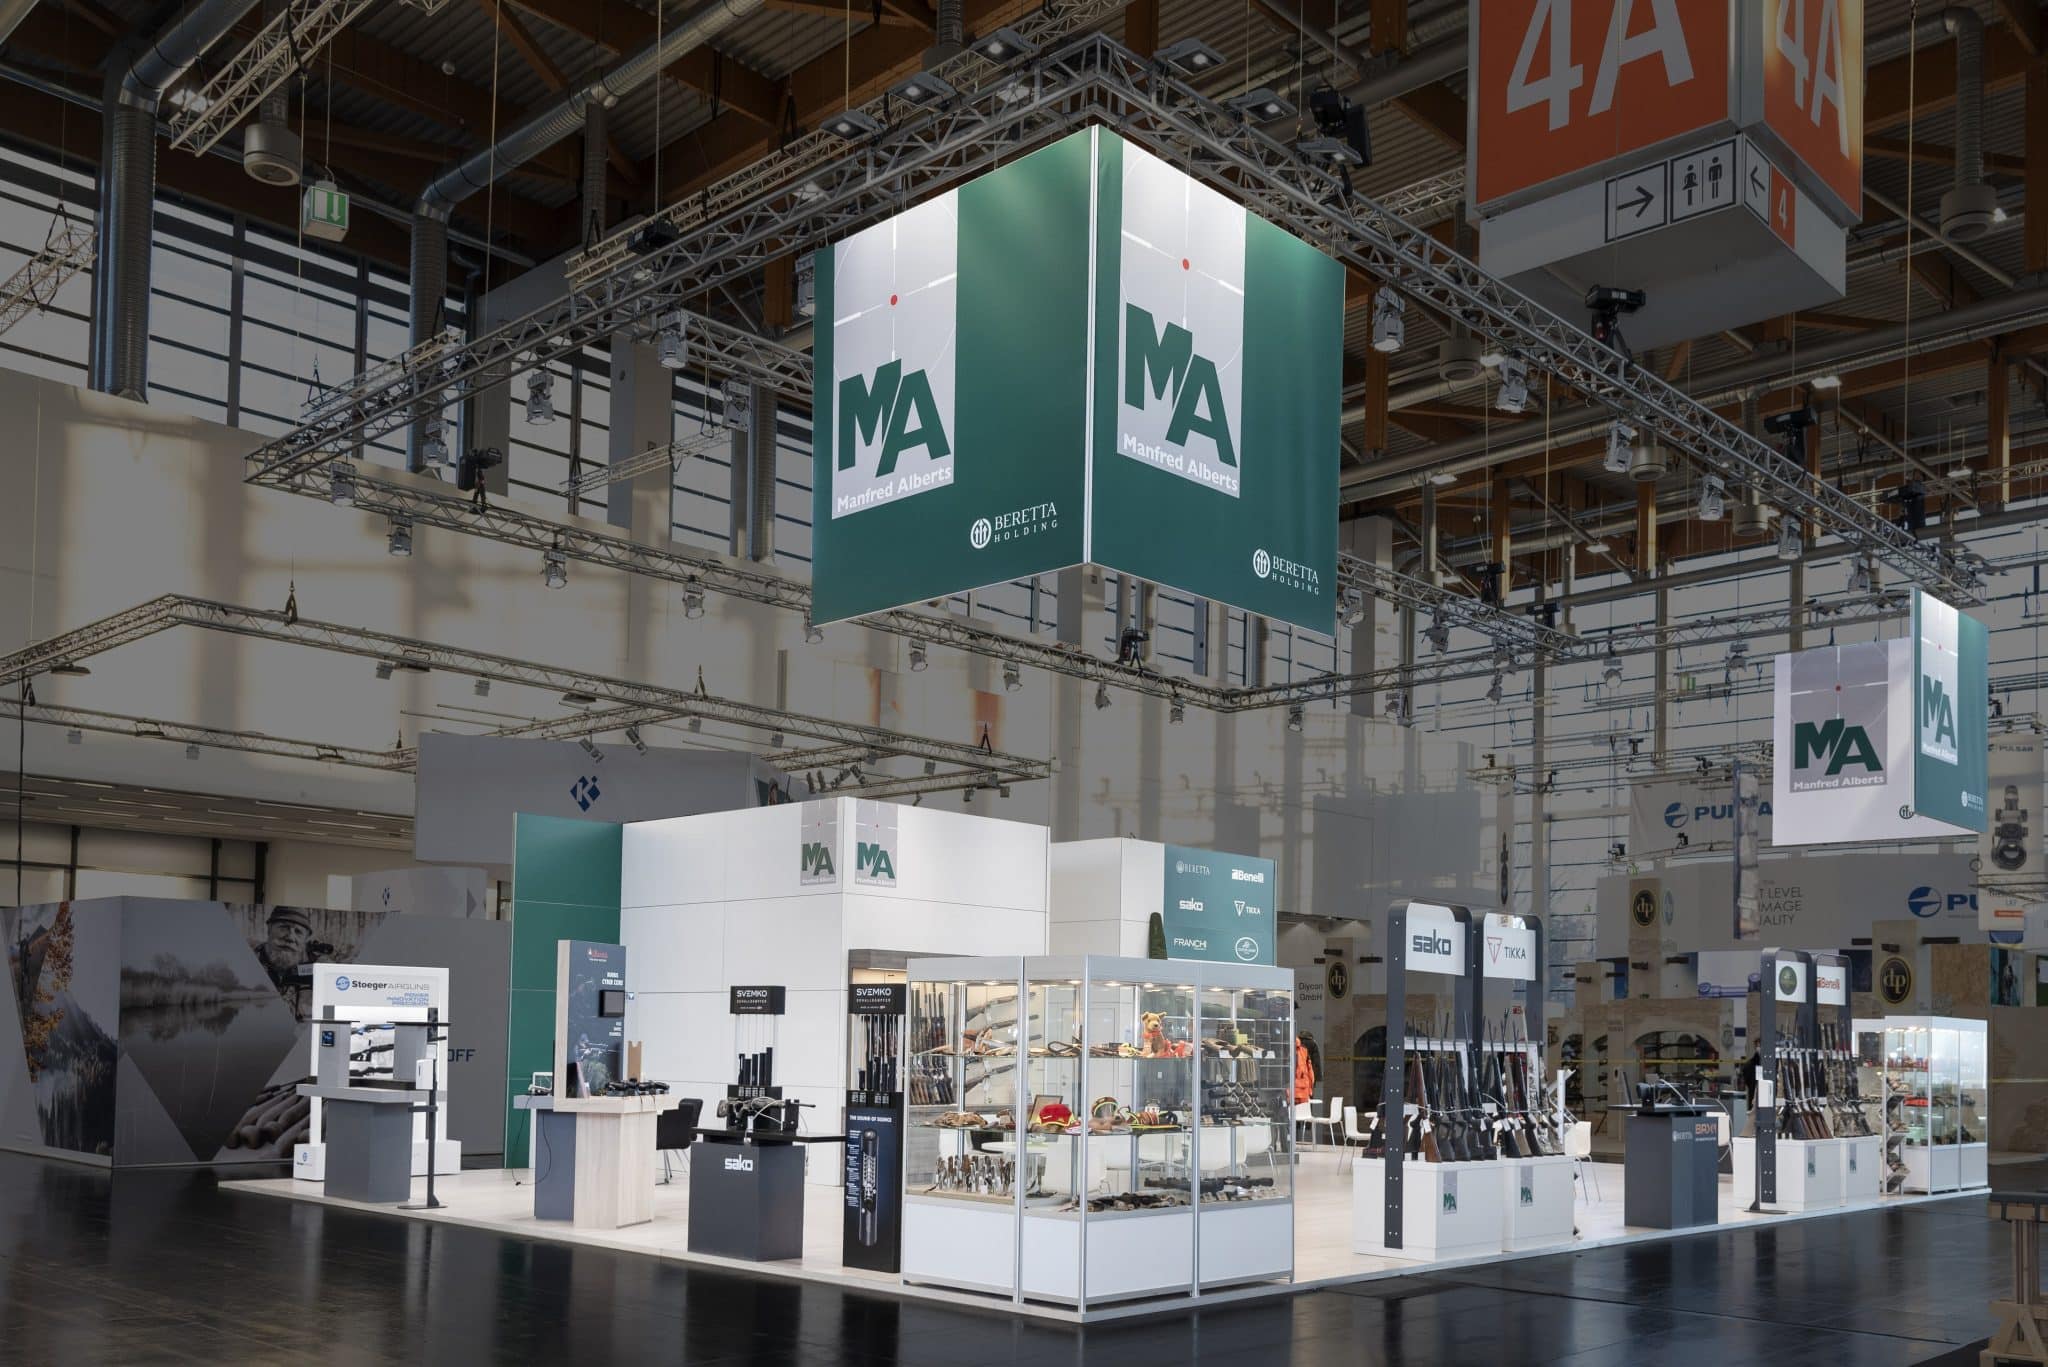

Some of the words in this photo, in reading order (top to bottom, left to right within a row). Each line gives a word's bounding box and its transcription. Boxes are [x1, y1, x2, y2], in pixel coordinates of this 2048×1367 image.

[1507, 0, 1695, 132] 4A
[1776, 0, 1850, 161] 4A
[1778, 188, 1788, 230] 4
[1125, 302, 1238, 468] MA
[838, 358, 951, 478] MA
[1123, 433, 1184, 471] Manfred
[1187, 460, 1238, 491] Alberts
[837, 481, 893, 513] Manfred
[897, 466, 951, 493] Alberts
[994, 501, 1057, 531] BERETTA
[994, 519, 1058, 543] HOLDING
[1272, 555, 1319, 584] BERETTA
[1272, 572, 1319, 596] HOLDING
[1923, 673, 1957, 749] MA
[1794, 718, 1884, 776] MA
[1793, 778, 1839, 791] Manfred
[1842, 775, 1885, 786] Alberts
[802, 842, 835, 876] MA
[857, 841, 896, 880] MA
[1184, 863, 1211, 876] BERETTA
[1239, 869, 1265, 883] Benelli
[1179, 897, 1204, 912] sako
[1768, 886, 1804, 899] LEVEL
[1758, 900, 1803, 912] IMAGE
[1173, 937, 1207, 949] FRANCHI
[1412, 929, 1452, 956] sako
[1504, 946, 1527, 960] TIKKA
[351, 980, 388, 991] Stoeger
[388, 983, 430, 991] AIRGUNS
[736, 990, 768, 998] SVEMKO
[856, 988, 892, 996] SVEMKO
[725, 1154, 754, 1171] sako
[1443, 1193, 1457, 1211] MA
